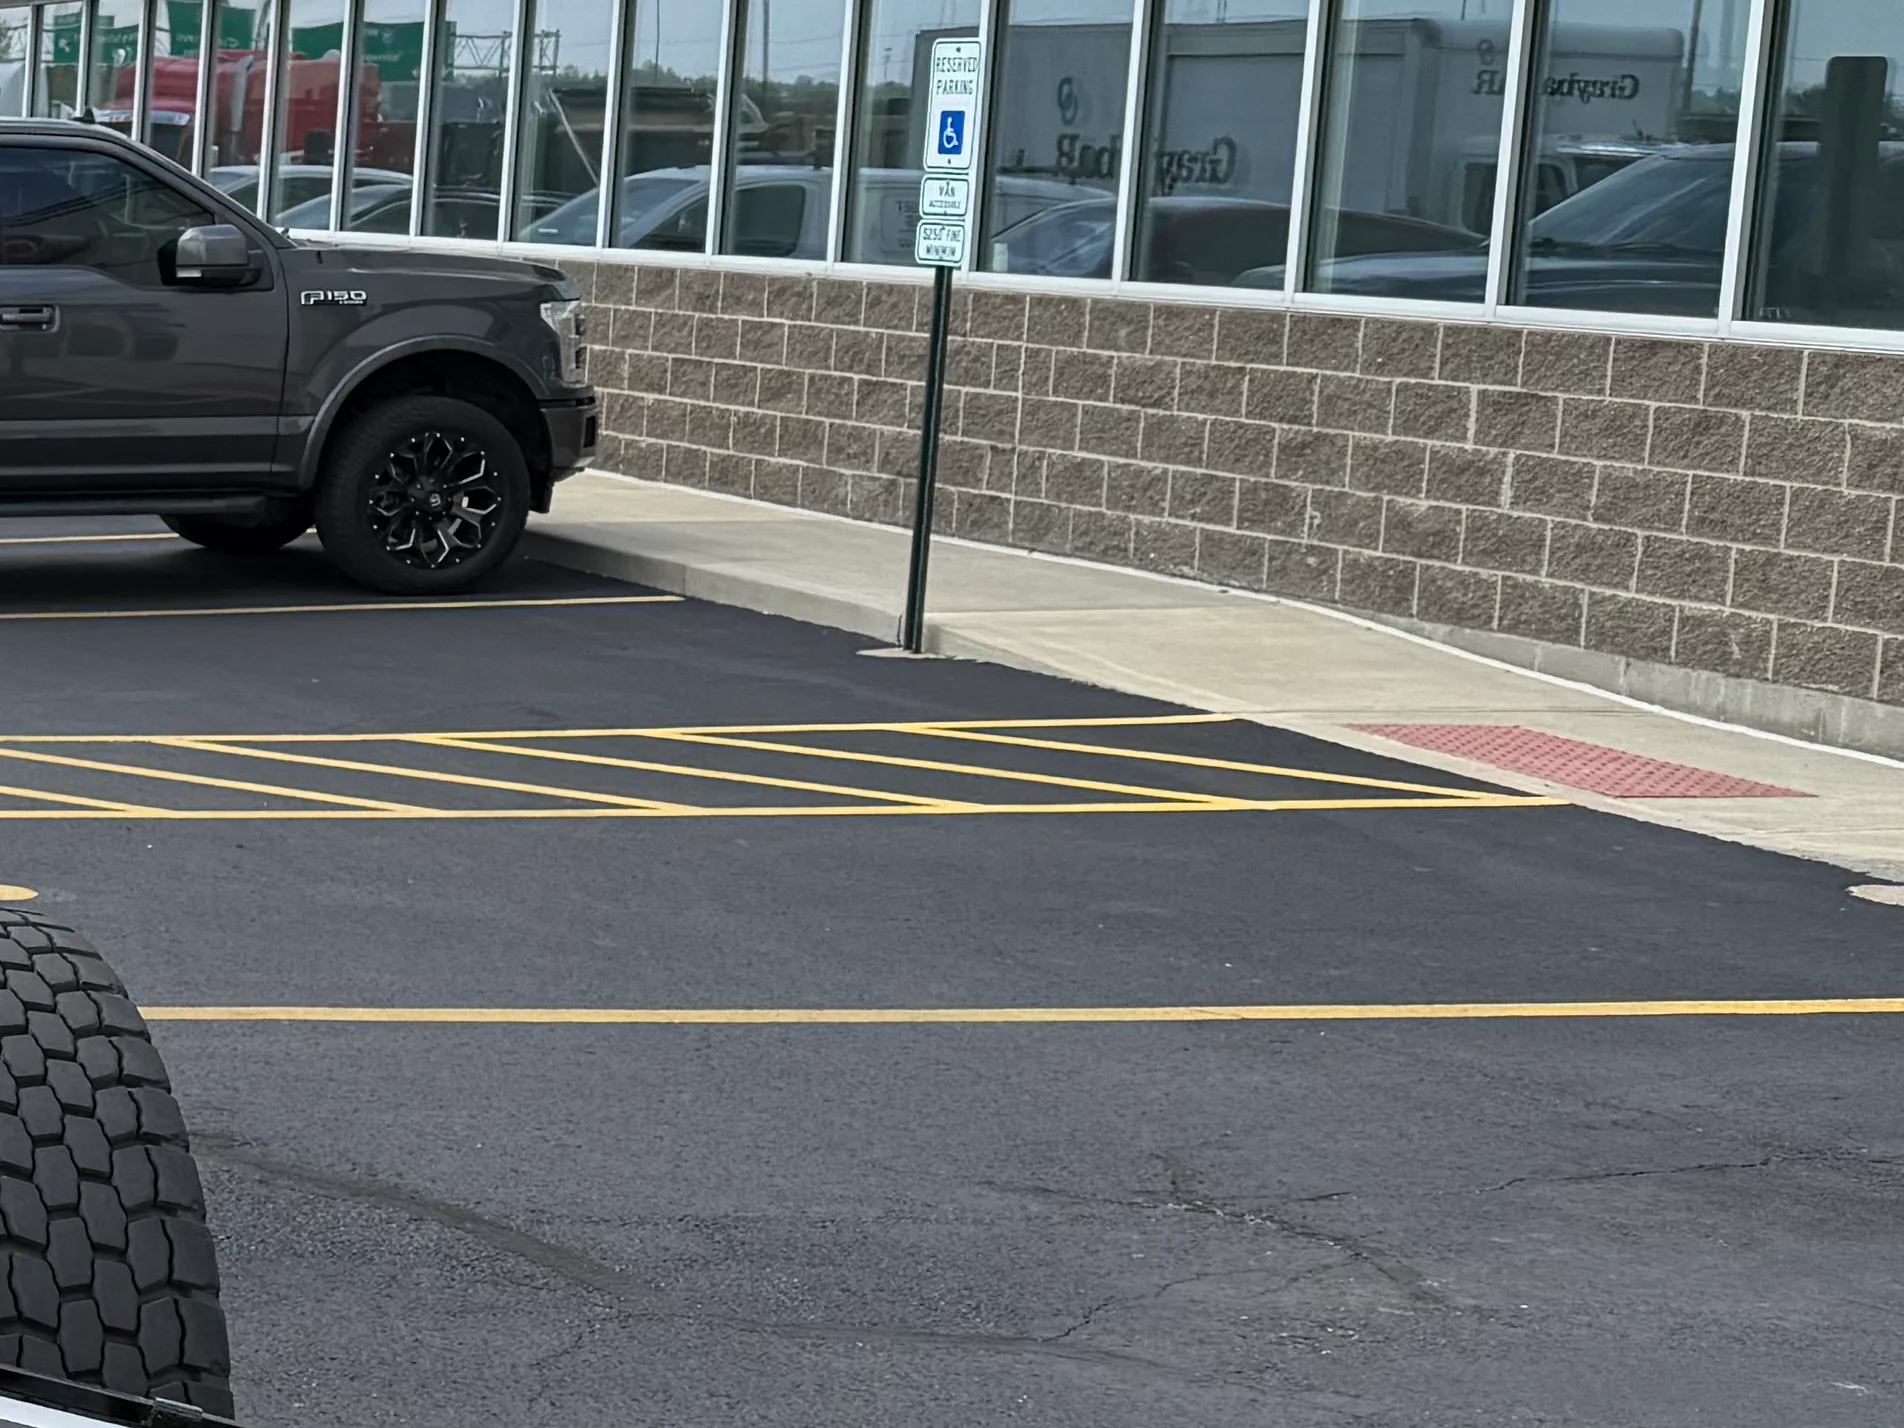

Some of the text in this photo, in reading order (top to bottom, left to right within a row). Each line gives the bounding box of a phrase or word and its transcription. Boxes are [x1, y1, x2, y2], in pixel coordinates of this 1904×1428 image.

[935, 56, 978, 73] RESERVED
[936, 79, 973, 95] PARKING
[938, 184, 956, 198] VAN
